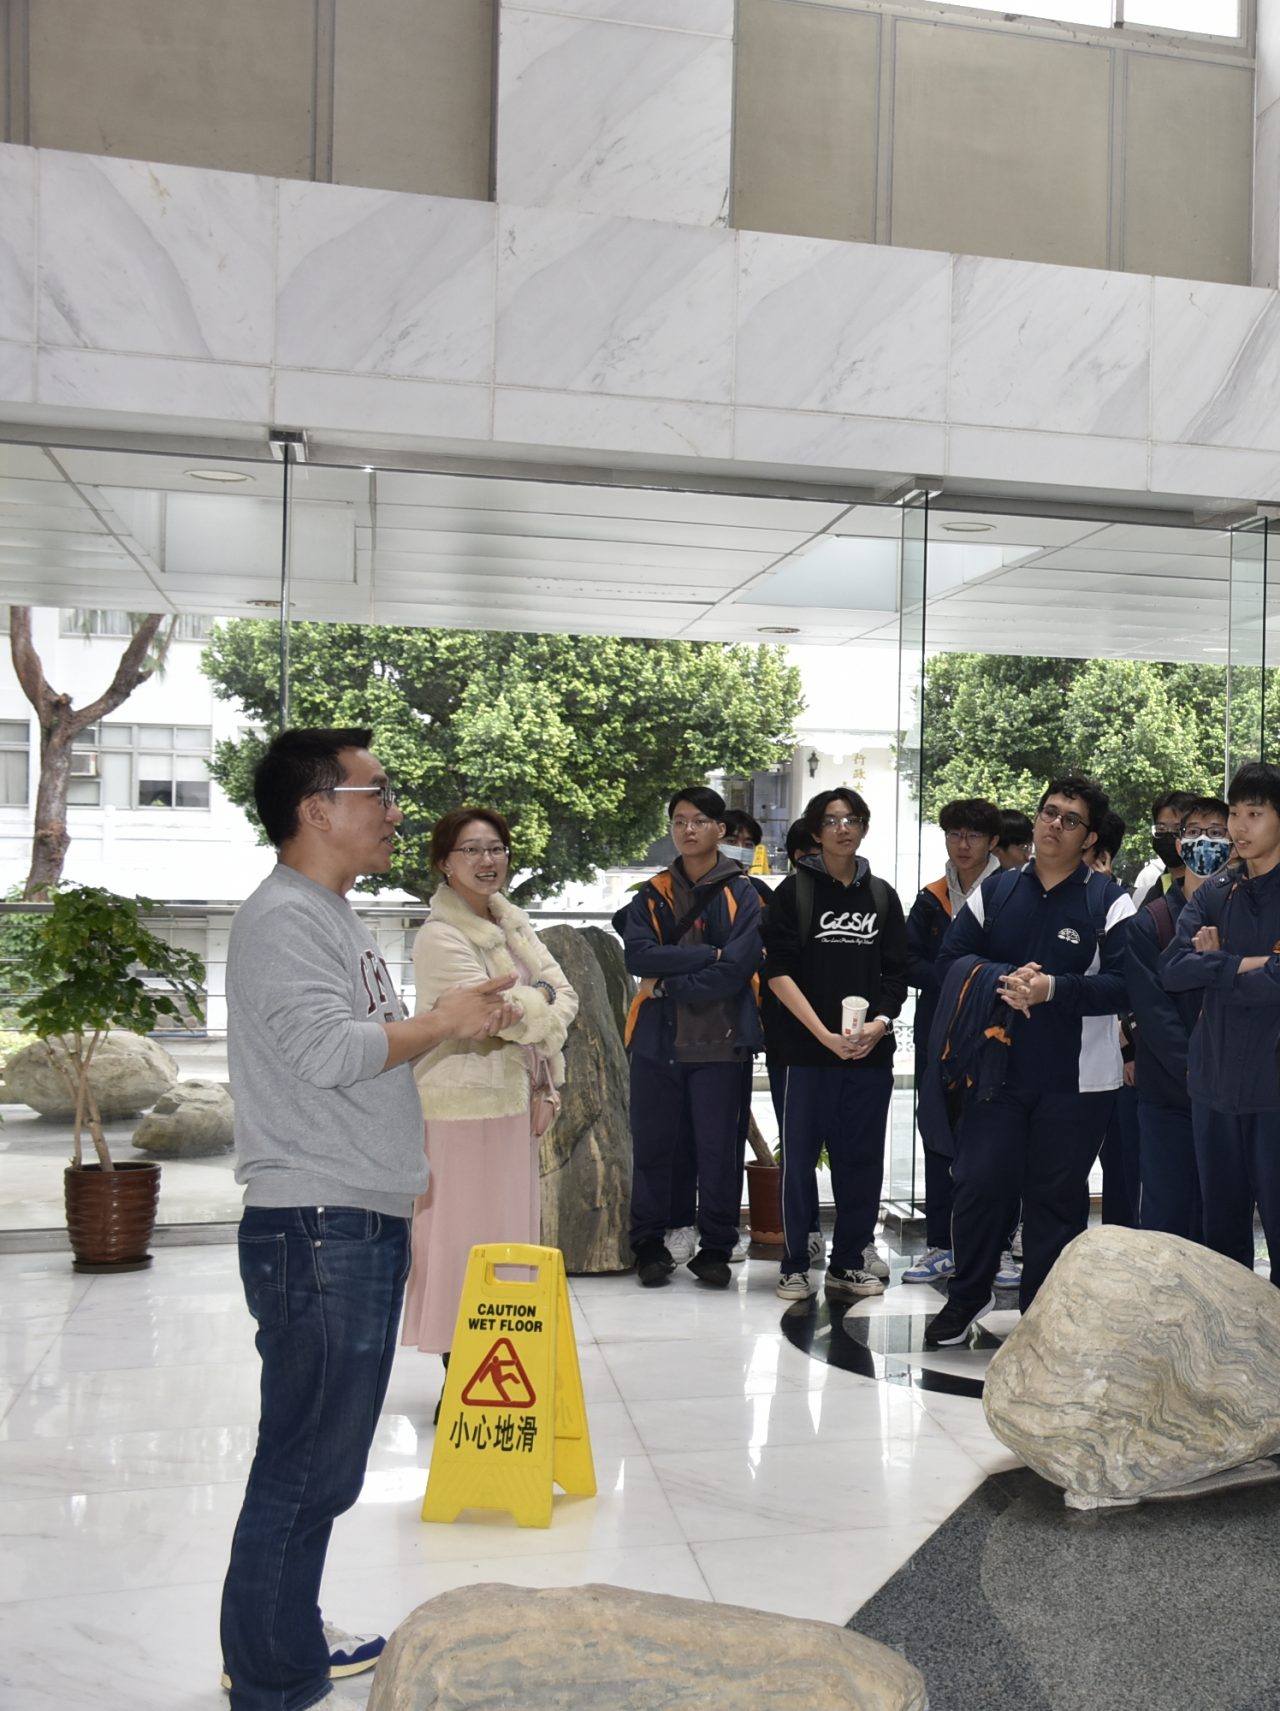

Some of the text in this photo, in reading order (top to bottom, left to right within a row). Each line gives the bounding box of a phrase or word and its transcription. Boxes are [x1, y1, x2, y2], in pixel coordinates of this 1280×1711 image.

[820, 911, 877, 933] CLSH
[477, 1304, 536, 1317] CAUTION
[468, 1318, 543, 1332] WET FLOOR
[450, 1412, 537, 1452] 小心地滑
